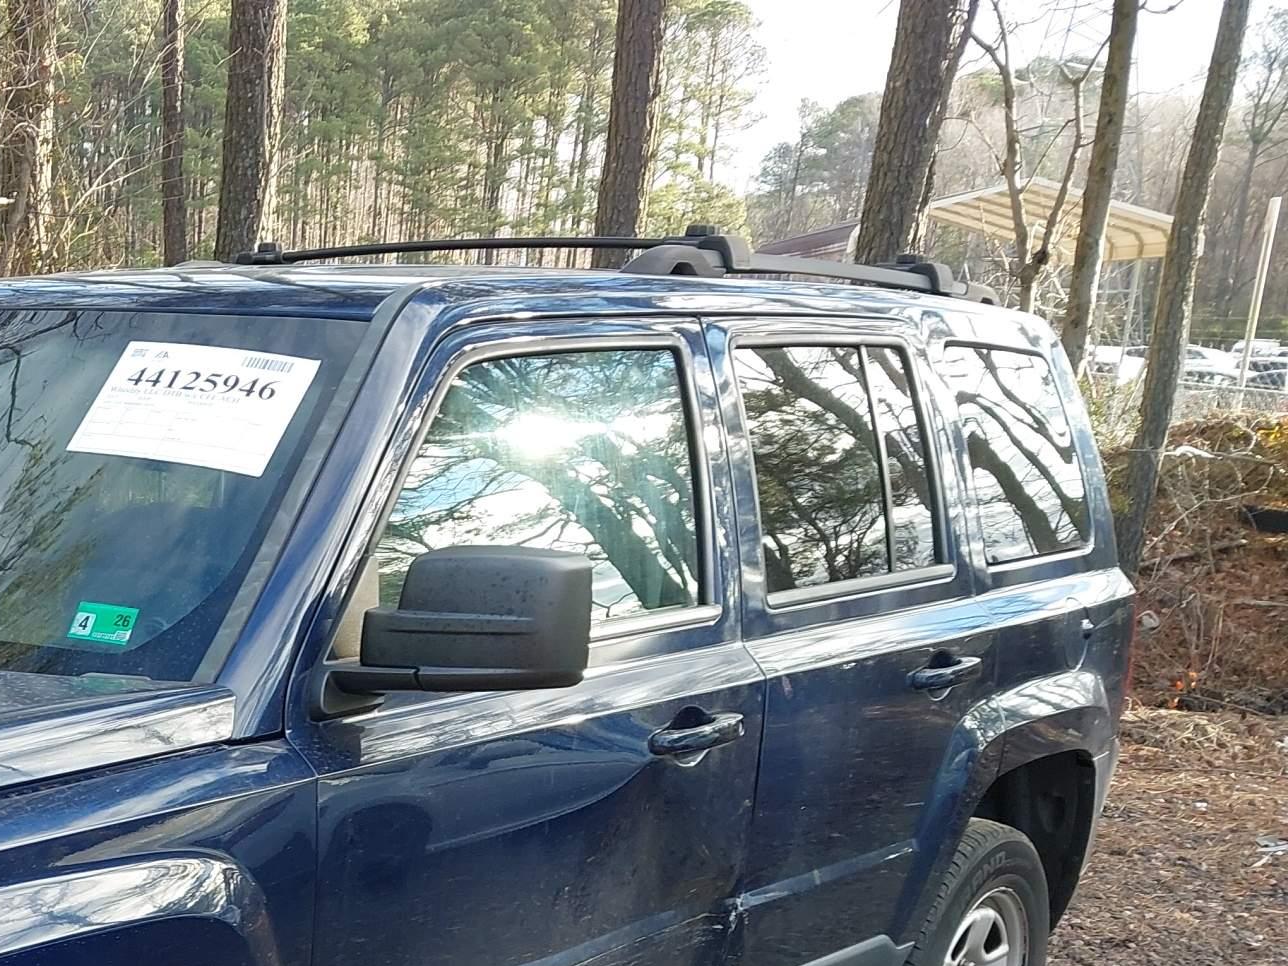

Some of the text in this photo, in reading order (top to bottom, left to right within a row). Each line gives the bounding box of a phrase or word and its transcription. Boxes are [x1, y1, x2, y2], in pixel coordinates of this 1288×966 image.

[127, 367, 282, 401] 44125946
[78, 614, 132, 631] 4 26
